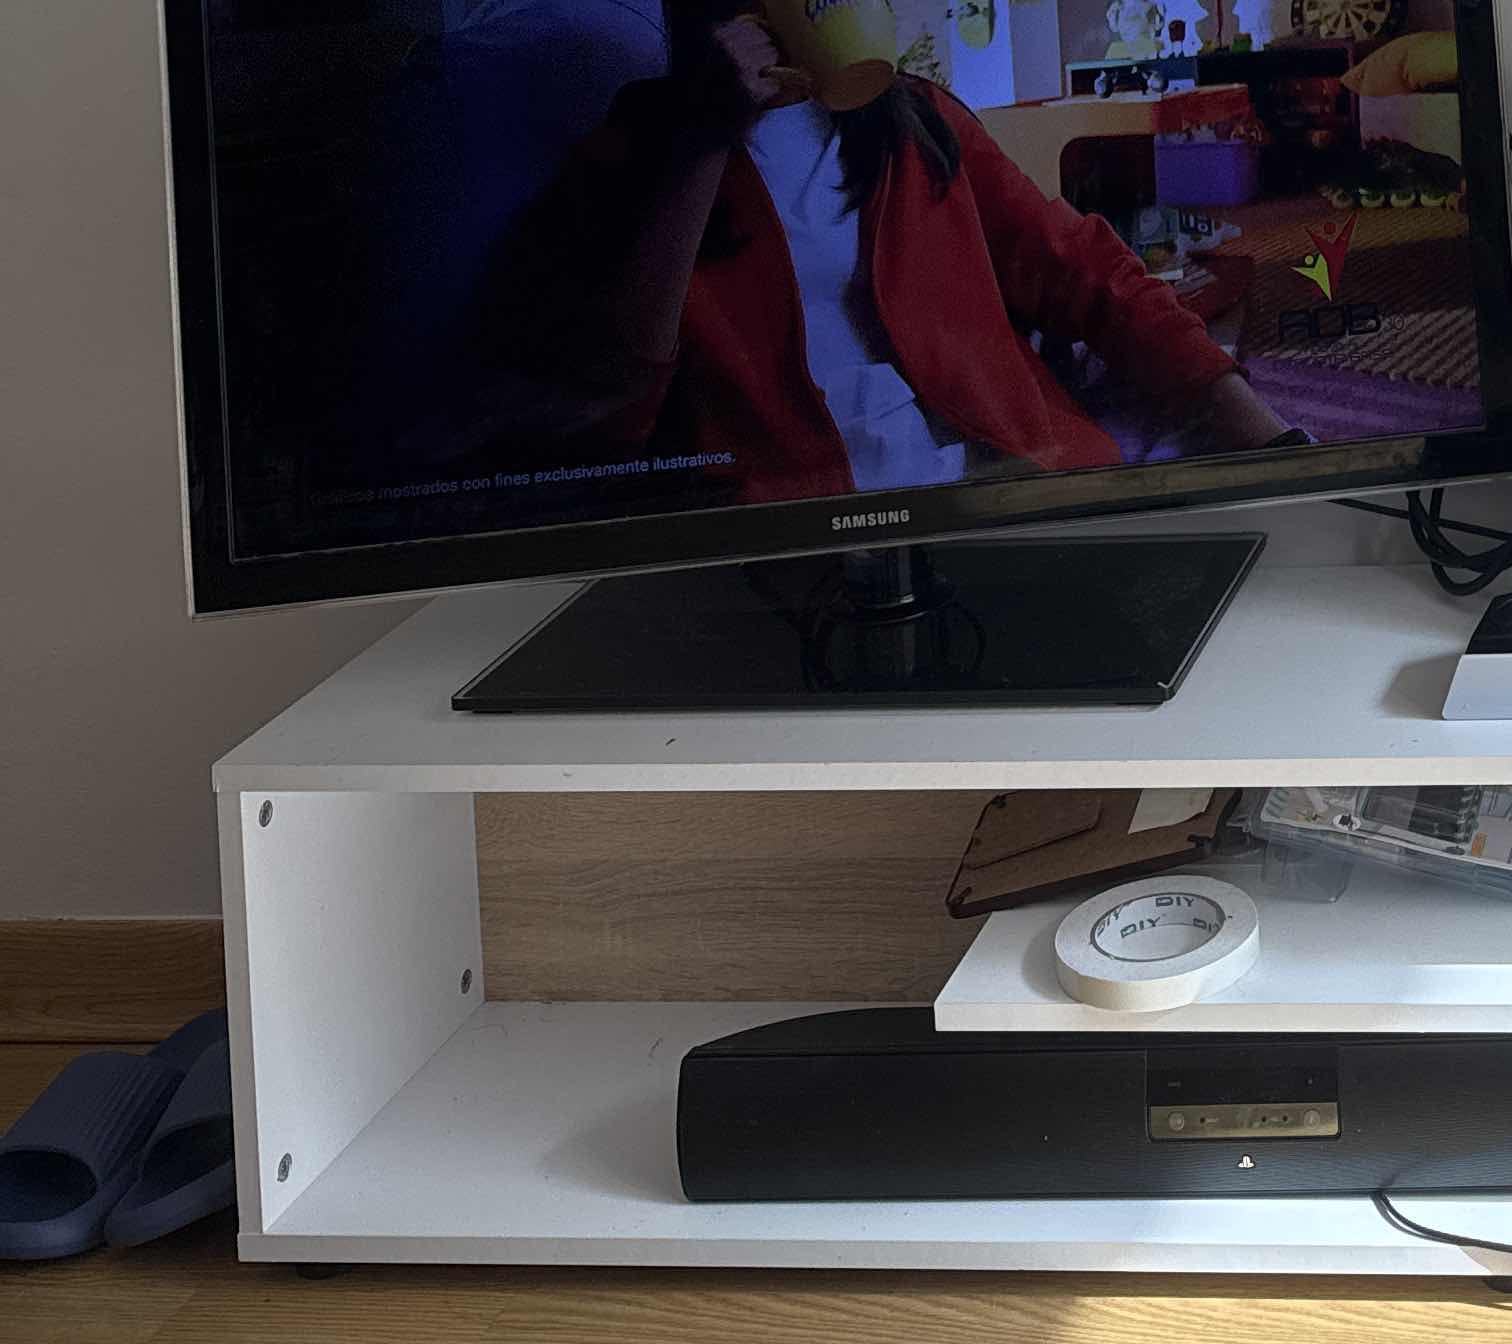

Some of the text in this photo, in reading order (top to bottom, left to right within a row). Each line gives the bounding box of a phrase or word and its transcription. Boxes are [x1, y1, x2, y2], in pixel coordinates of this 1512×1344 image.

[378, 479, 458, 500] mostrados
[461, 476, 491, 491] con
[495, 471, 530, 488] fines
[533, 458, 649, 483] exclusivamente
[652, 450, 737, 472] ilustrativos.
[831, 509, 910, 531] SAMSUNG
[1155, 896, 1195, 908] DIY
[1120, 916, 1161, 939] DIY
